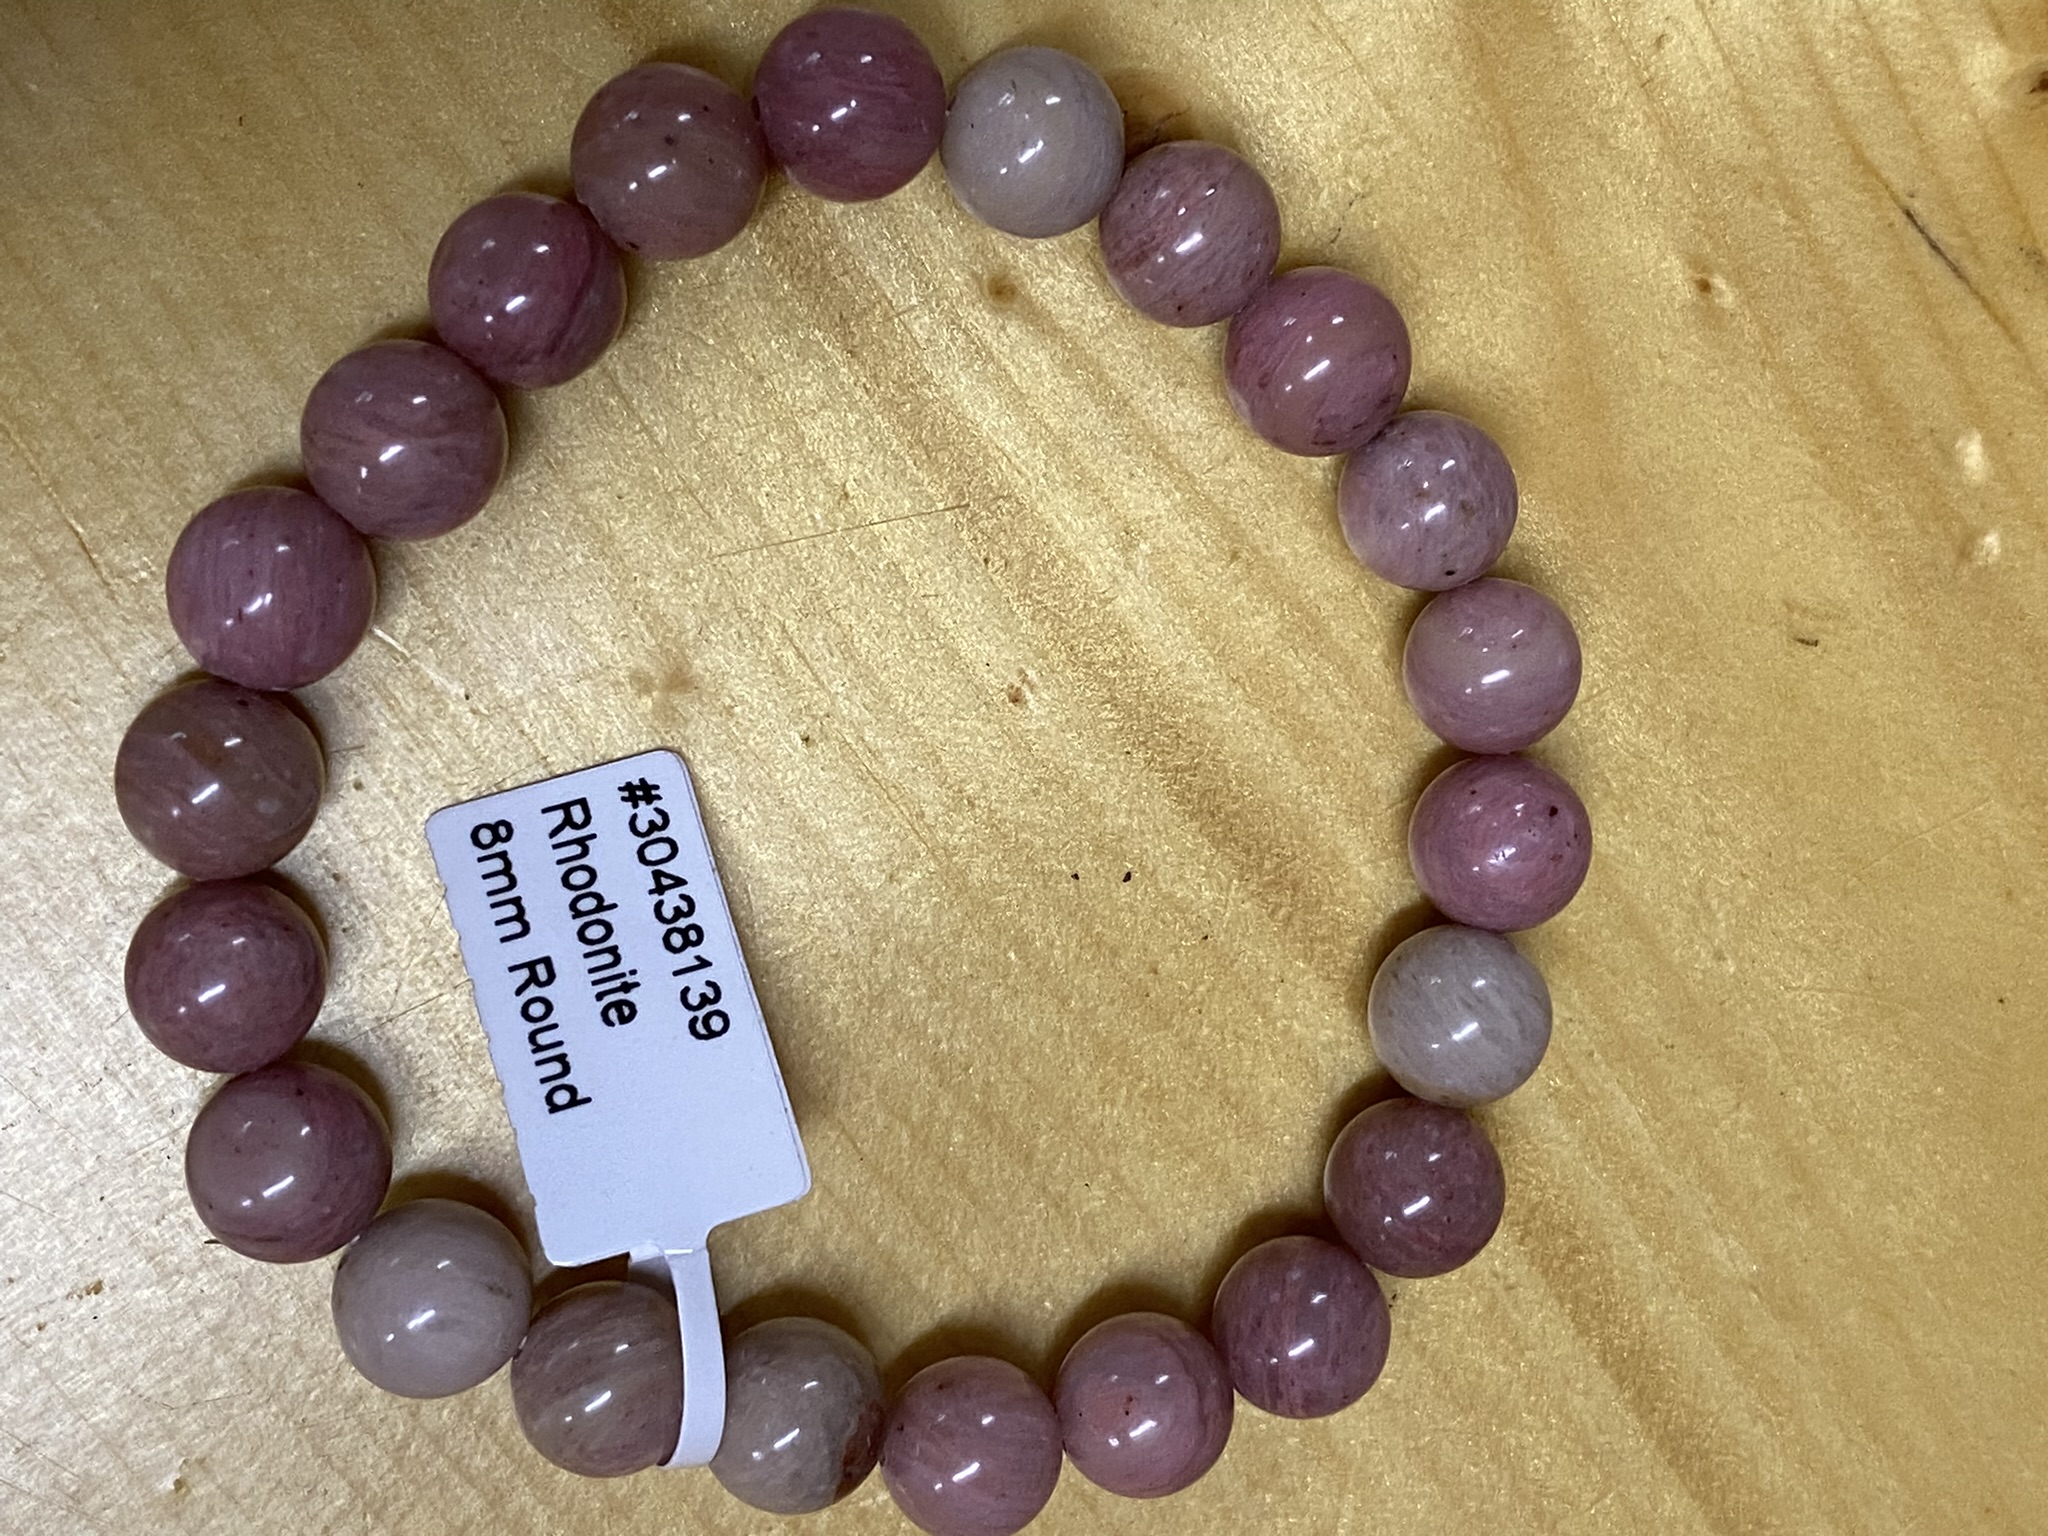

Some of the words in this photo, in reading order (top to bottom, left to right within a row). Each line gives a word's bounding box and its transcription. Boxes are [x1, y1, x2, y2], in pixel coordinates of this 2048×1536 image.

[469, 819, 531, 944] 8mm
[507, 955, 593, 1115] Round
[540, 796, 642, 1028] Rhodonite
[617, 777, 731, 1041] #30438139
